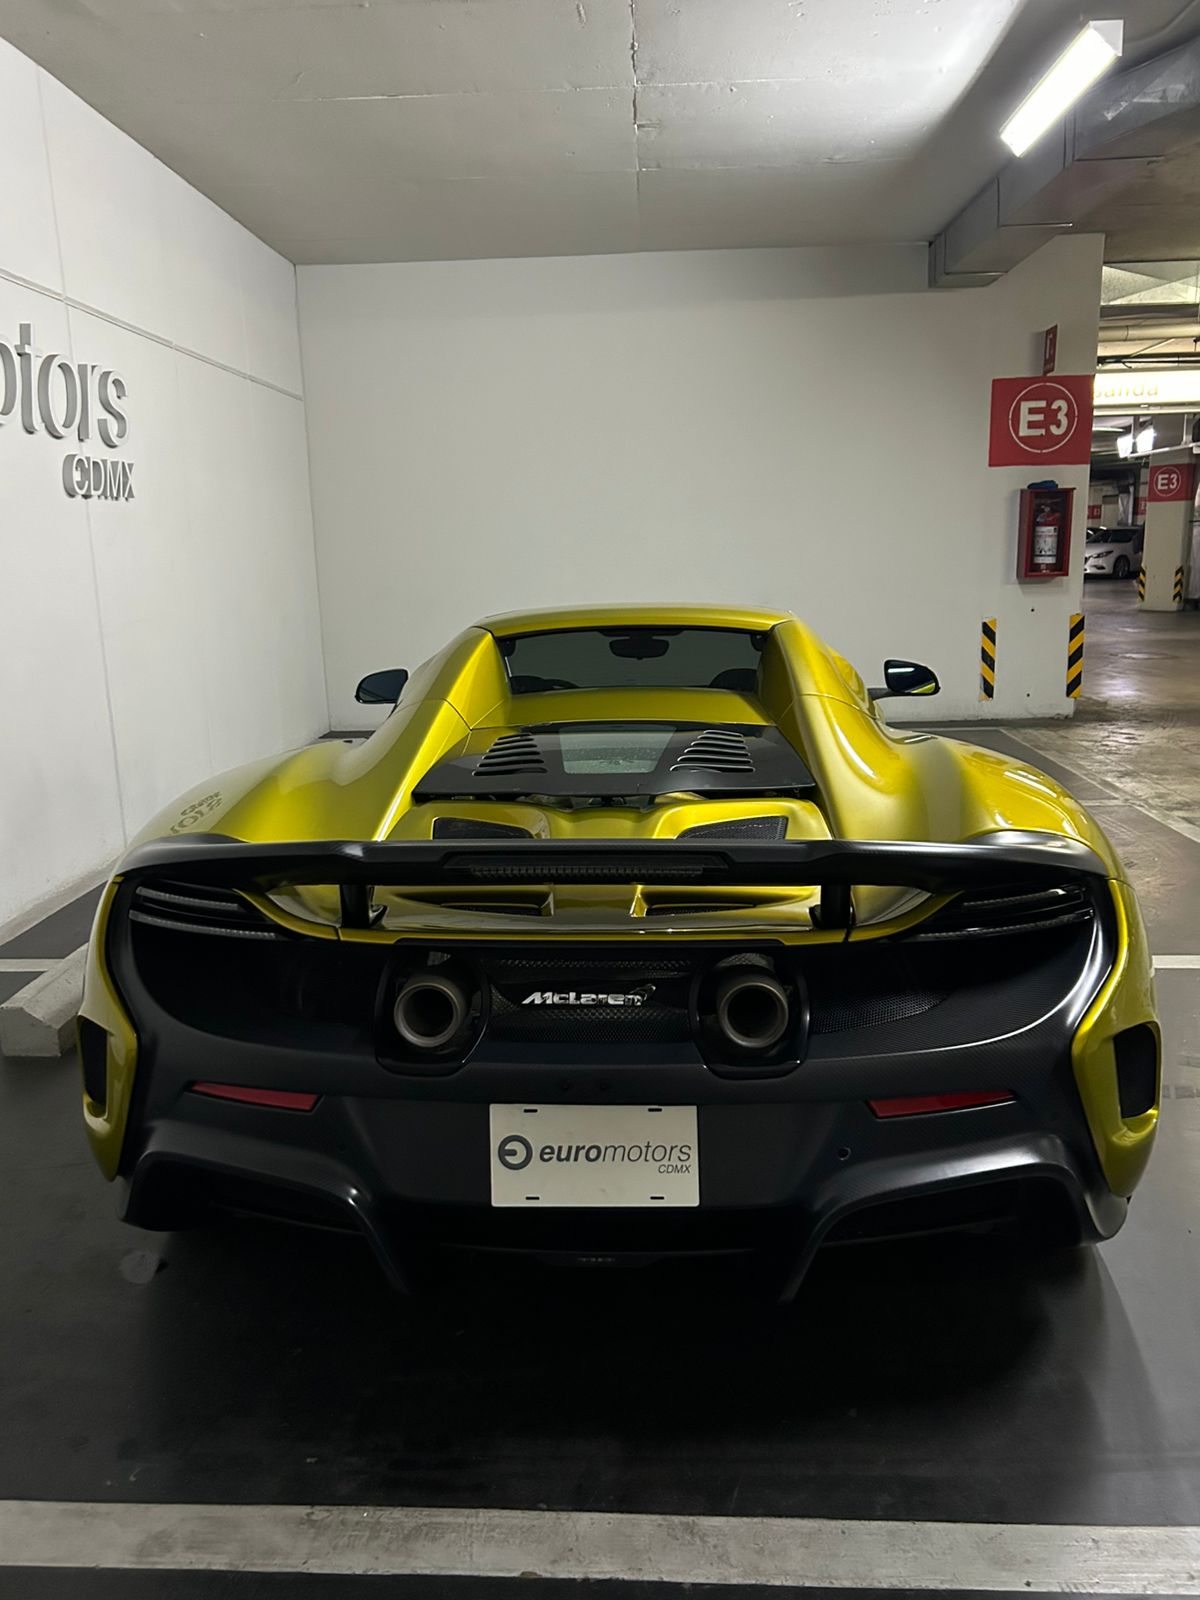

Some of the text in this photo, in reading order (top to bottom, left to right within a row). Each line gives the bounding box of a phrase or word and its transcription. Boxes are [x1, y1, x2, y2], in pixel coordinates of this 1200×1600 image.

[1018, 398, 1069, 437] E3
[62, 453, 136, 501] CDMX
[1157, 474, 1178, 490] E3
[521, 991, 643, 1006] McLaren
[539, 1140, 692, 1163] euromotors
[657, 1164, 692, 1175] CDMX
